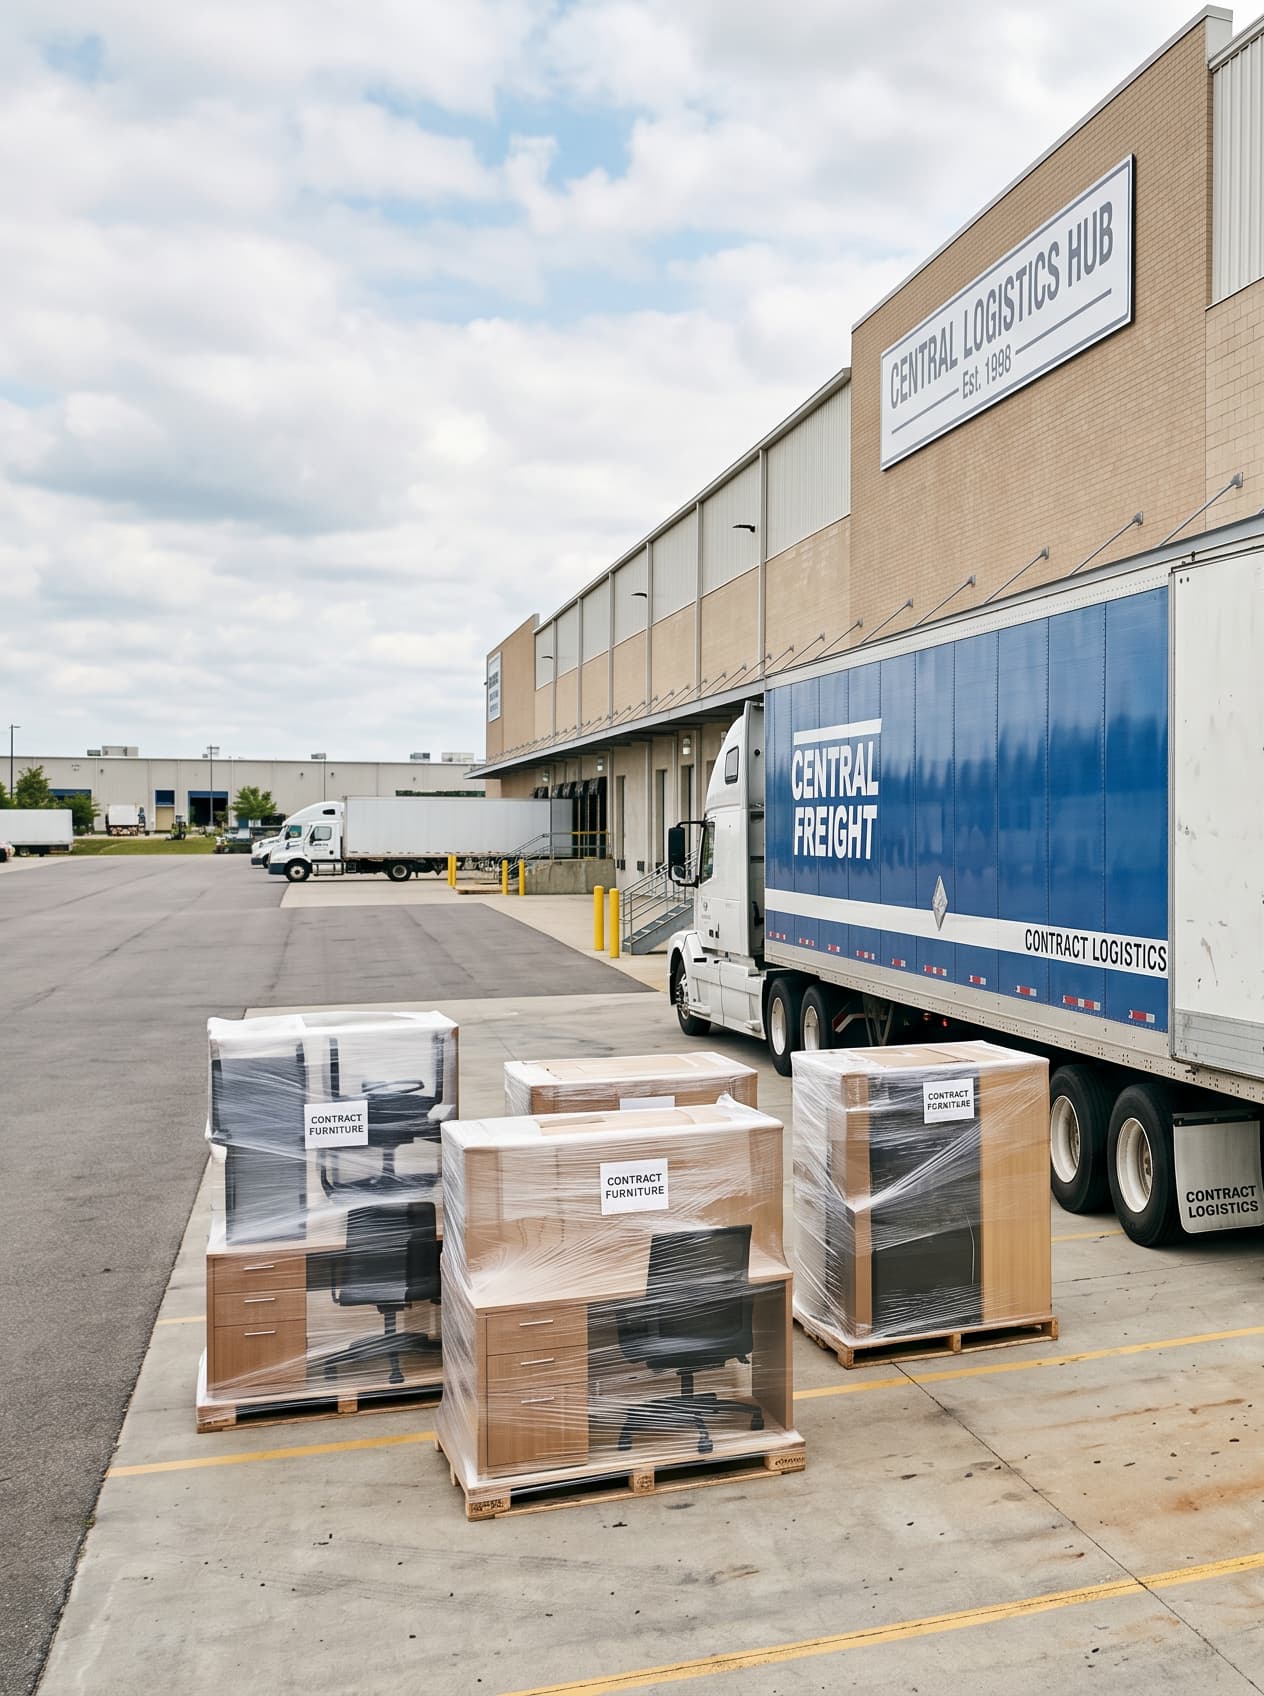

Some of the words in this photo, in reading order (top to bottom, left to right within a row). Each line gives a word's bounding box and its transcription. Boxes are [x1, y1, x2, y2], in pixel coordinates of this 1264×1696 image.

[890, 320, 959, 409] CENTRAL
[963, 240, 1060, 360] LOGISTICS
[1067, 200, 1114, 288] HUB
[962, 365, 981, 399] Est.
[985, 343, 1011, 385] 1998
[791, 741, 879, 801] CENTRAL
[793, 804, 878, 860] FREIGHT
[1025, 929, 1088, 960] CONTRACT
[1092, 937, 1167, 972] LOGISTICS
[927, 1089, 969, 1101] CONTRACT
[311, 1113, 363, 1124] CONTRACT
[309, 1124, 364, 1135] FURNITURE
[607, 1172, 663, 1187] CONTRACT
[605, 1185, 665, 1200] FURNITURE
[1186, 1185, 1257, 1203] CONTRACT
[1188, 1200, 1259, 1219] LOGISTICS
